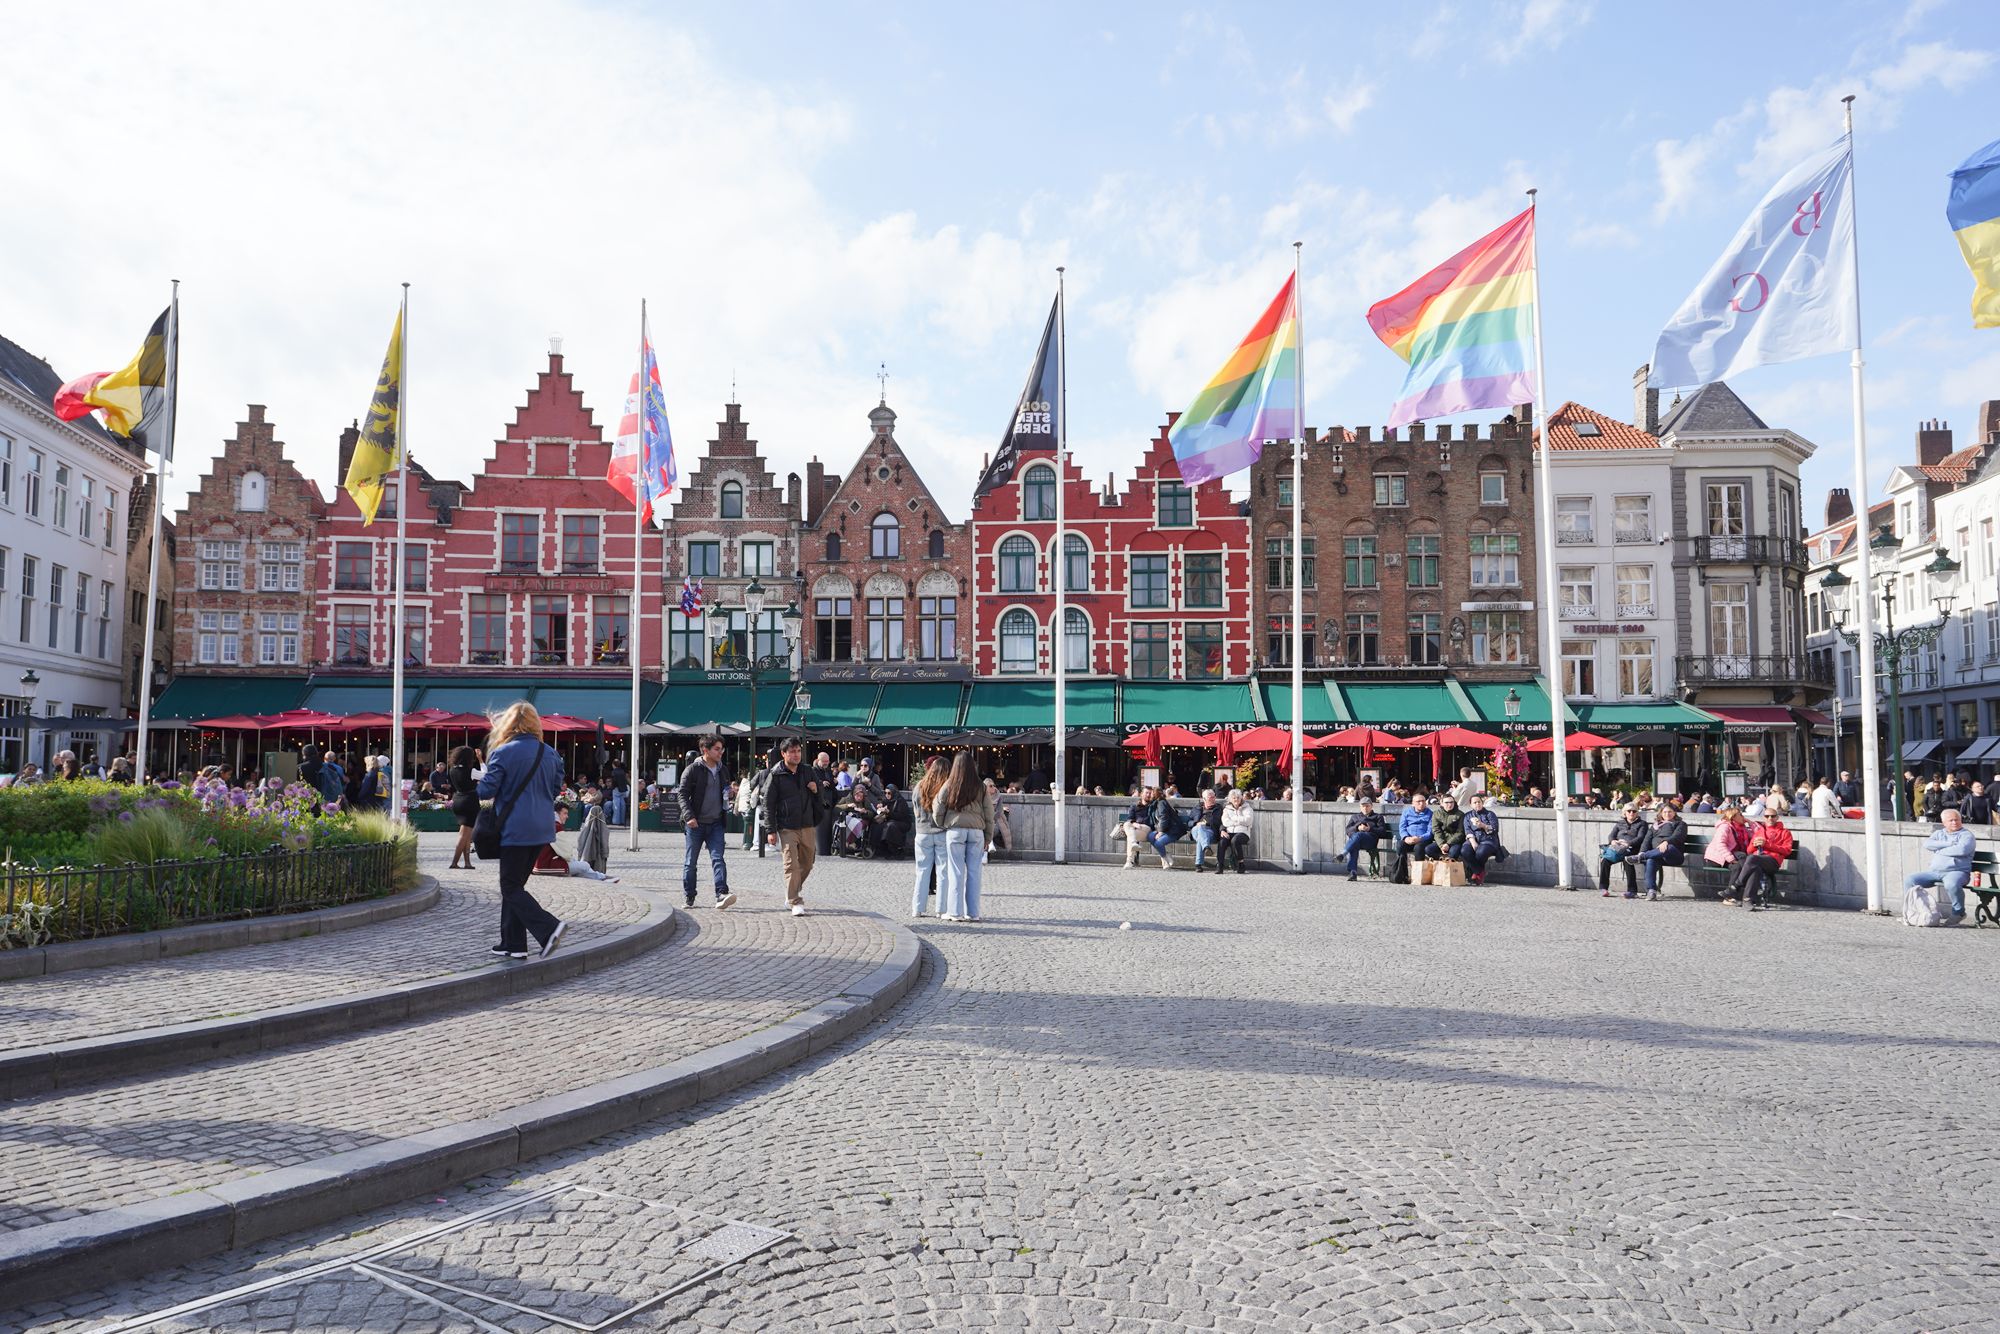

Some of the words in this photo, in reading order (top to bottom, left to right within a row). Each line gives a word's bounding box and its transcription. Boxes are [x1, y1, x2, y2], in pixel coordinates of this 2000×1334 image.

[1573, 624, 1619, 634] FRITERIE
[707, 672, 726, 680] SINT
[870, 665, 900, 680] Central
[912, 669, 949, 679] Brasserie
[1211, 722, 1257, 732] ARTS
[1277, 723, 1327, 731] Resurant
[1527, 723, 1547, 731] café
